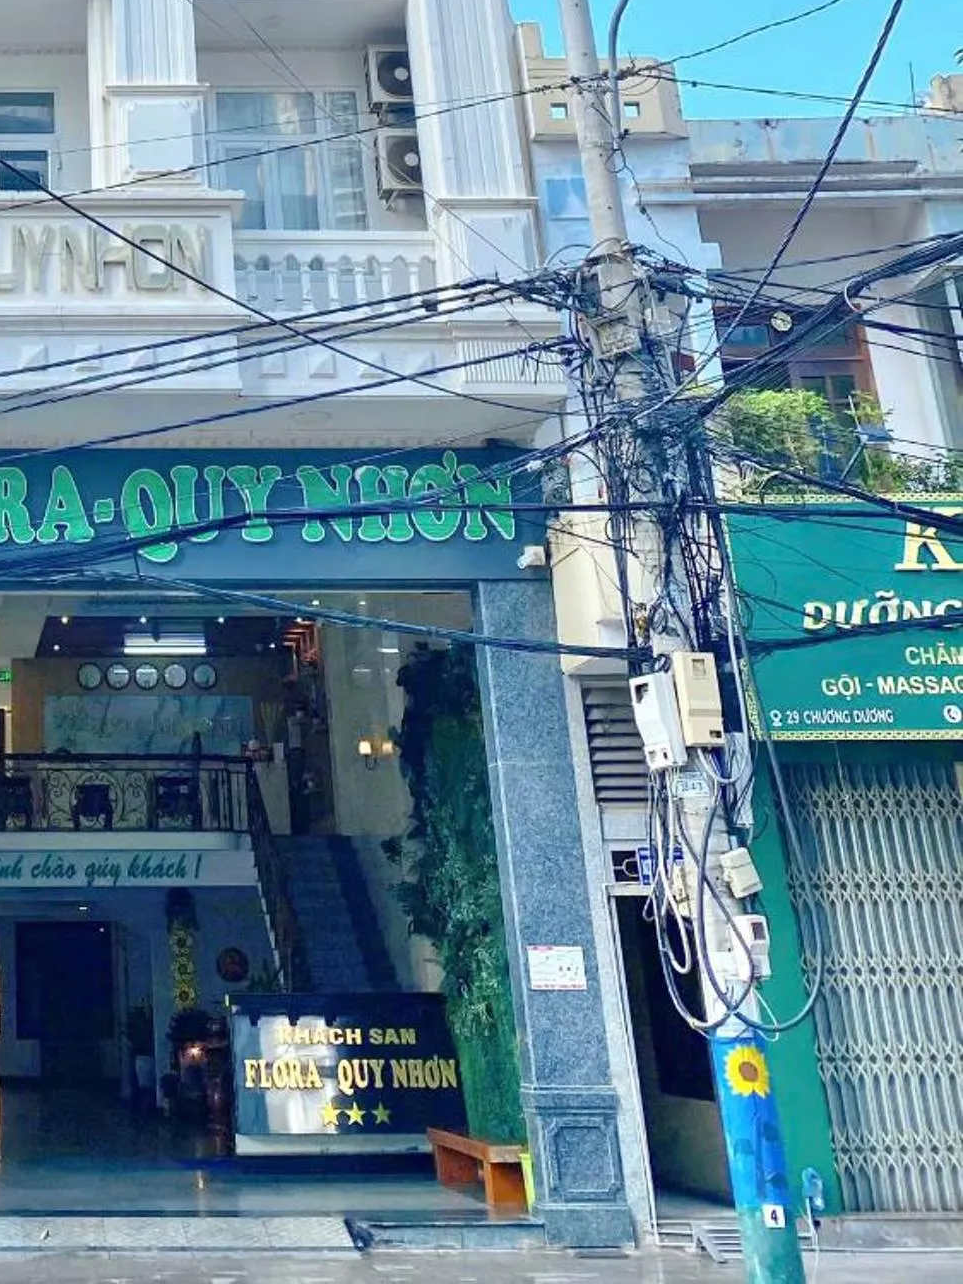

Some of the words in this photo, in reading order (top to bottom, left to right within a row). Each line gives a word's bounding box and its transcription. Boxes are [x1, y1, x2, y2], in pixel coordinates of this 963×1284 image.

[299, 451, 515, 542] NHƠN
[821, 673, 862, 701] GỘI
[787, 710, 799, 724] 29
[803, 709, 851, 724] CHƯƠNG
[854, 707, 894, 724] DƯƠNG
[30, 853, 77, 880] chào
[127, 853, 188, 880] khách
[337, 1057, 385, 1096] QUY
[389, 1053, 458, 1089] NHƠN
